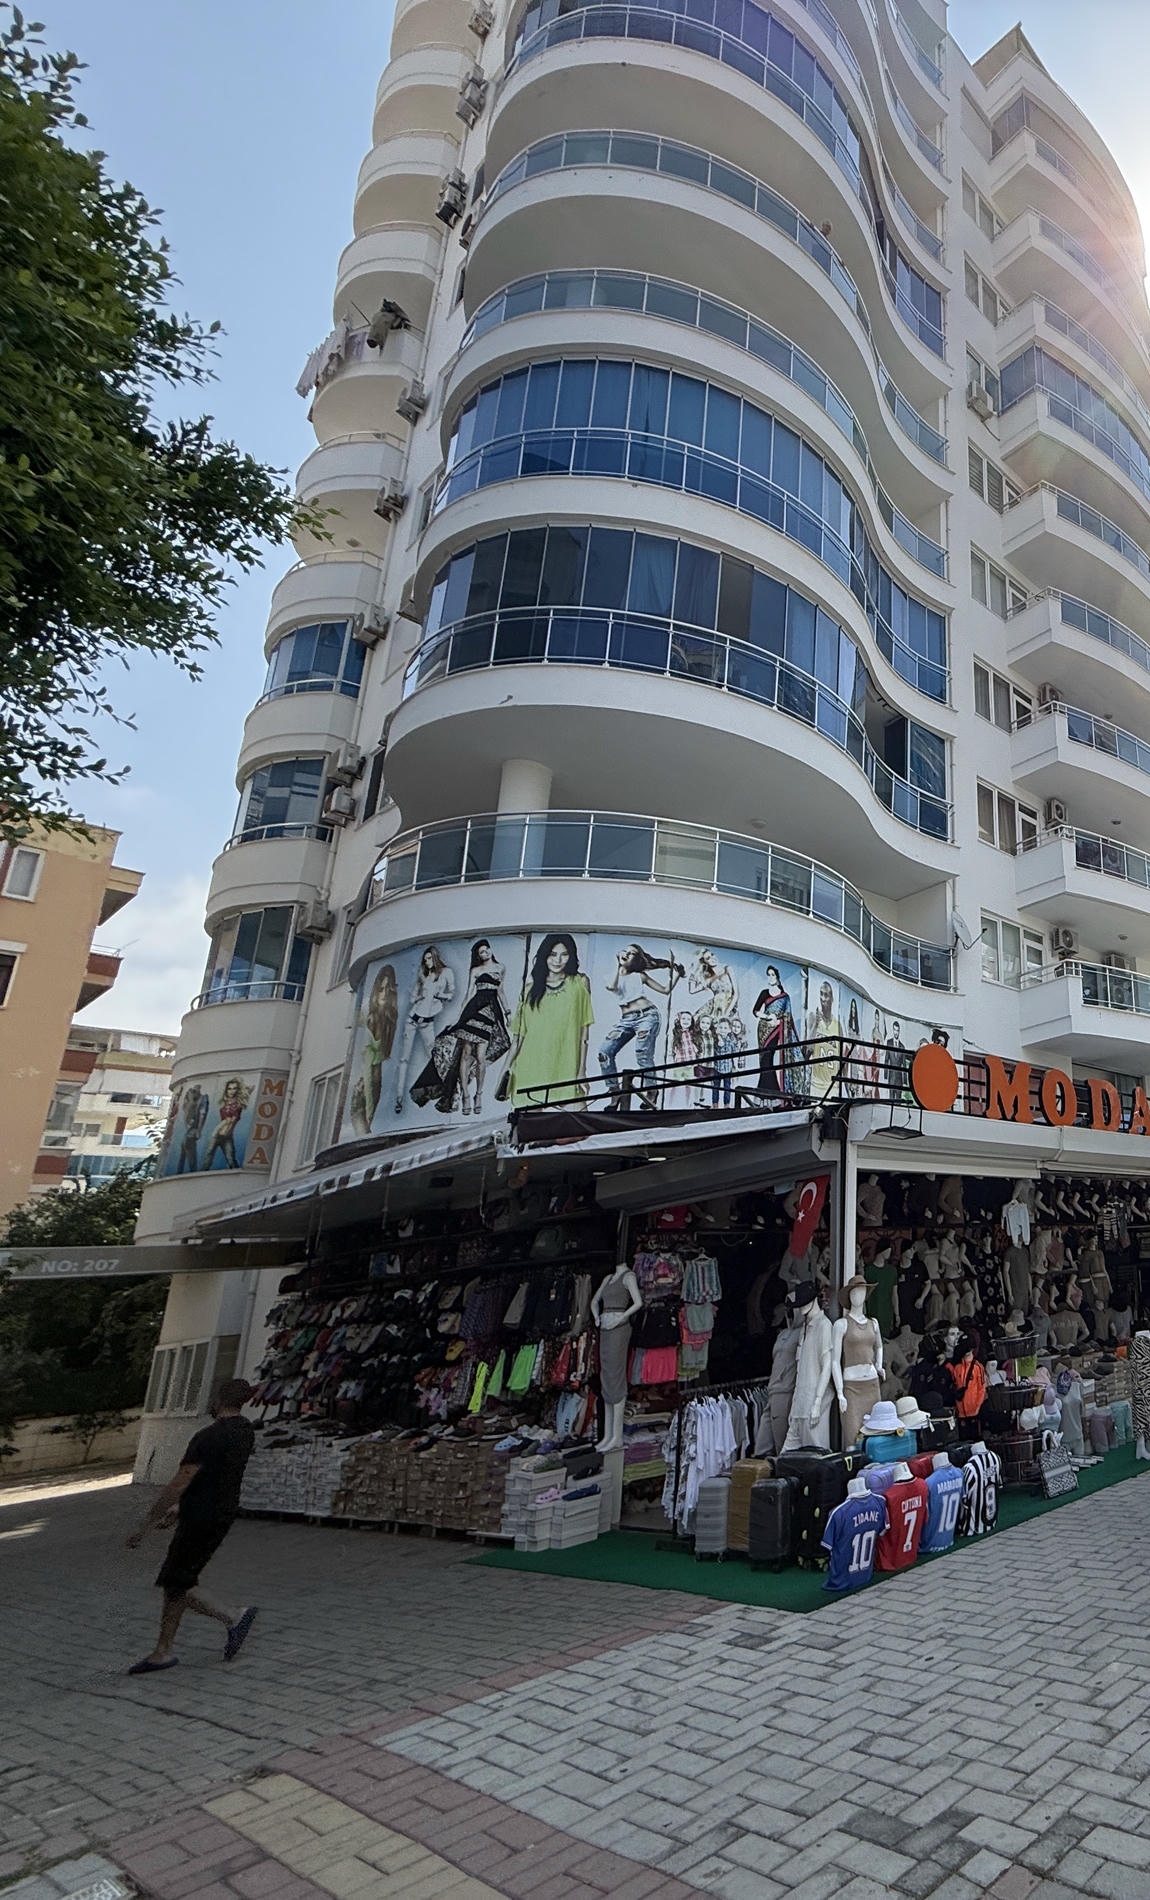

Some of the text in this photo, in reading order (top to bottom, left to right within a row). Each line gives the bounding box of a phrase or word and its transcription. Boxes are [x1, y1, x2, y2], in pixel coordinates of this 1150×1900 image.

[247, 1078, 286, 1165] MODA
[41, 1259, 120, 1273] NO: 207
[852, 1510, 880, 1527] ZIDANE
[903, 1510, 918, 1553] 7
[938, 1491, 961, 1533] 10
[848, 1530, 876, 1572] 10
